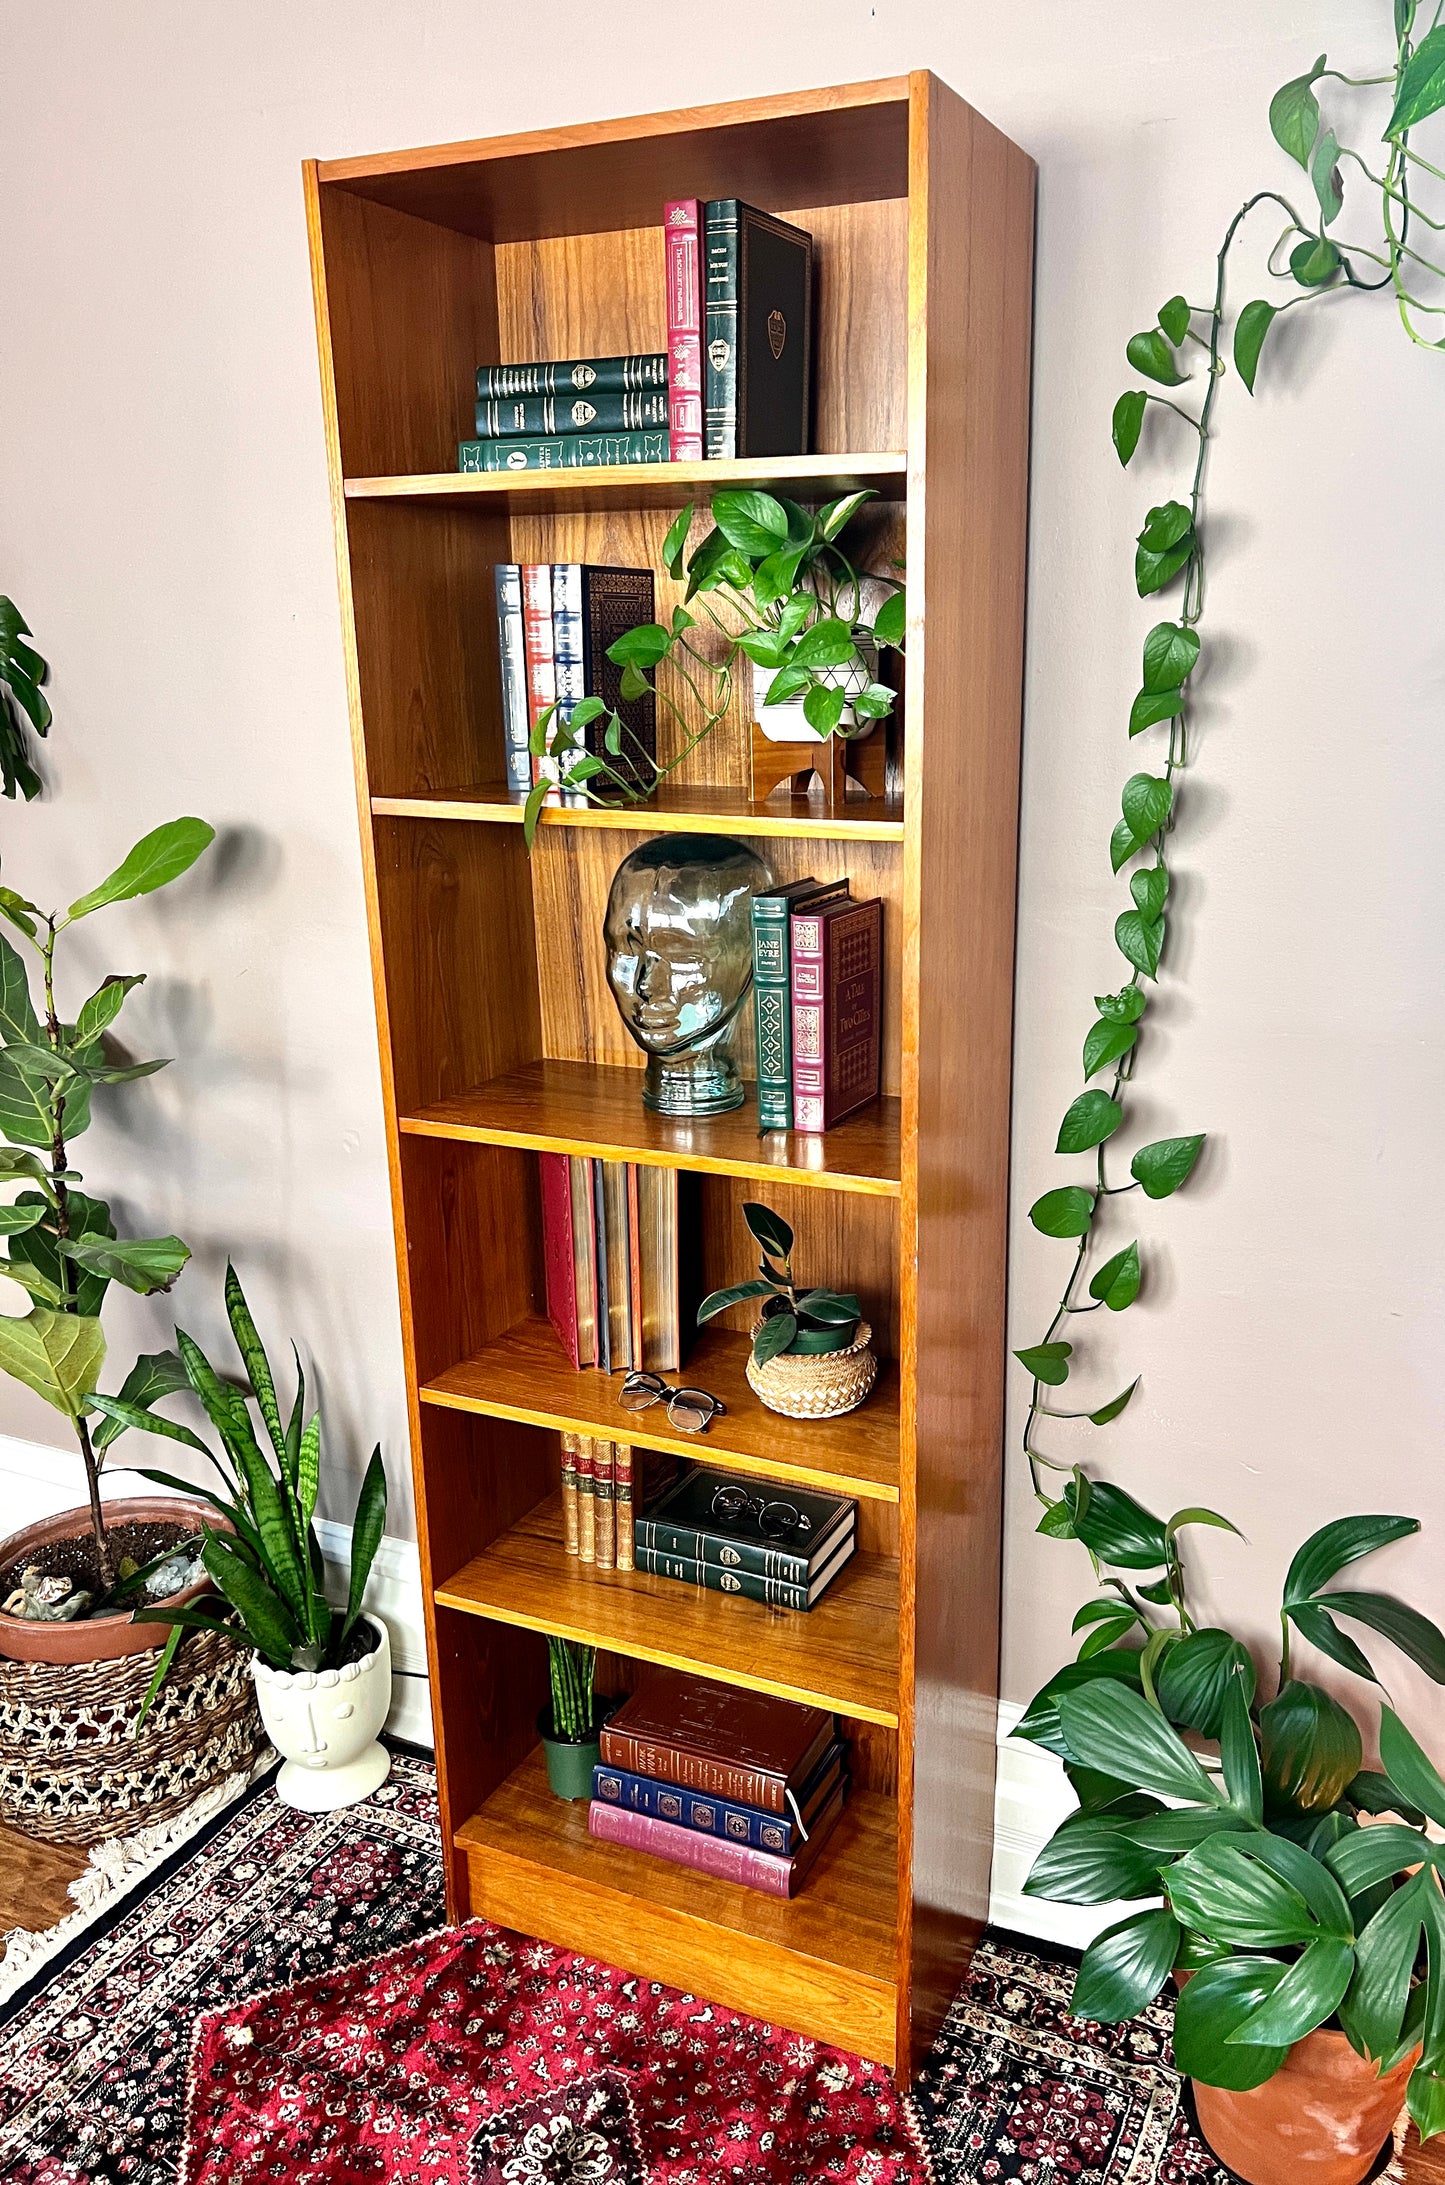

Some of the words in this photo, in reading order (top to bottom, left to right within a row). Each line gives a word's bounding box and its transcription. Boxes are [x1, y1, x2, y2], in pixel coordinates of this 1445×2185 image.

[758, 940, 779, 949] JANE
[758, 949, 780, 958] EYRE
[647, 1747, 656, 1774] TWAIN
